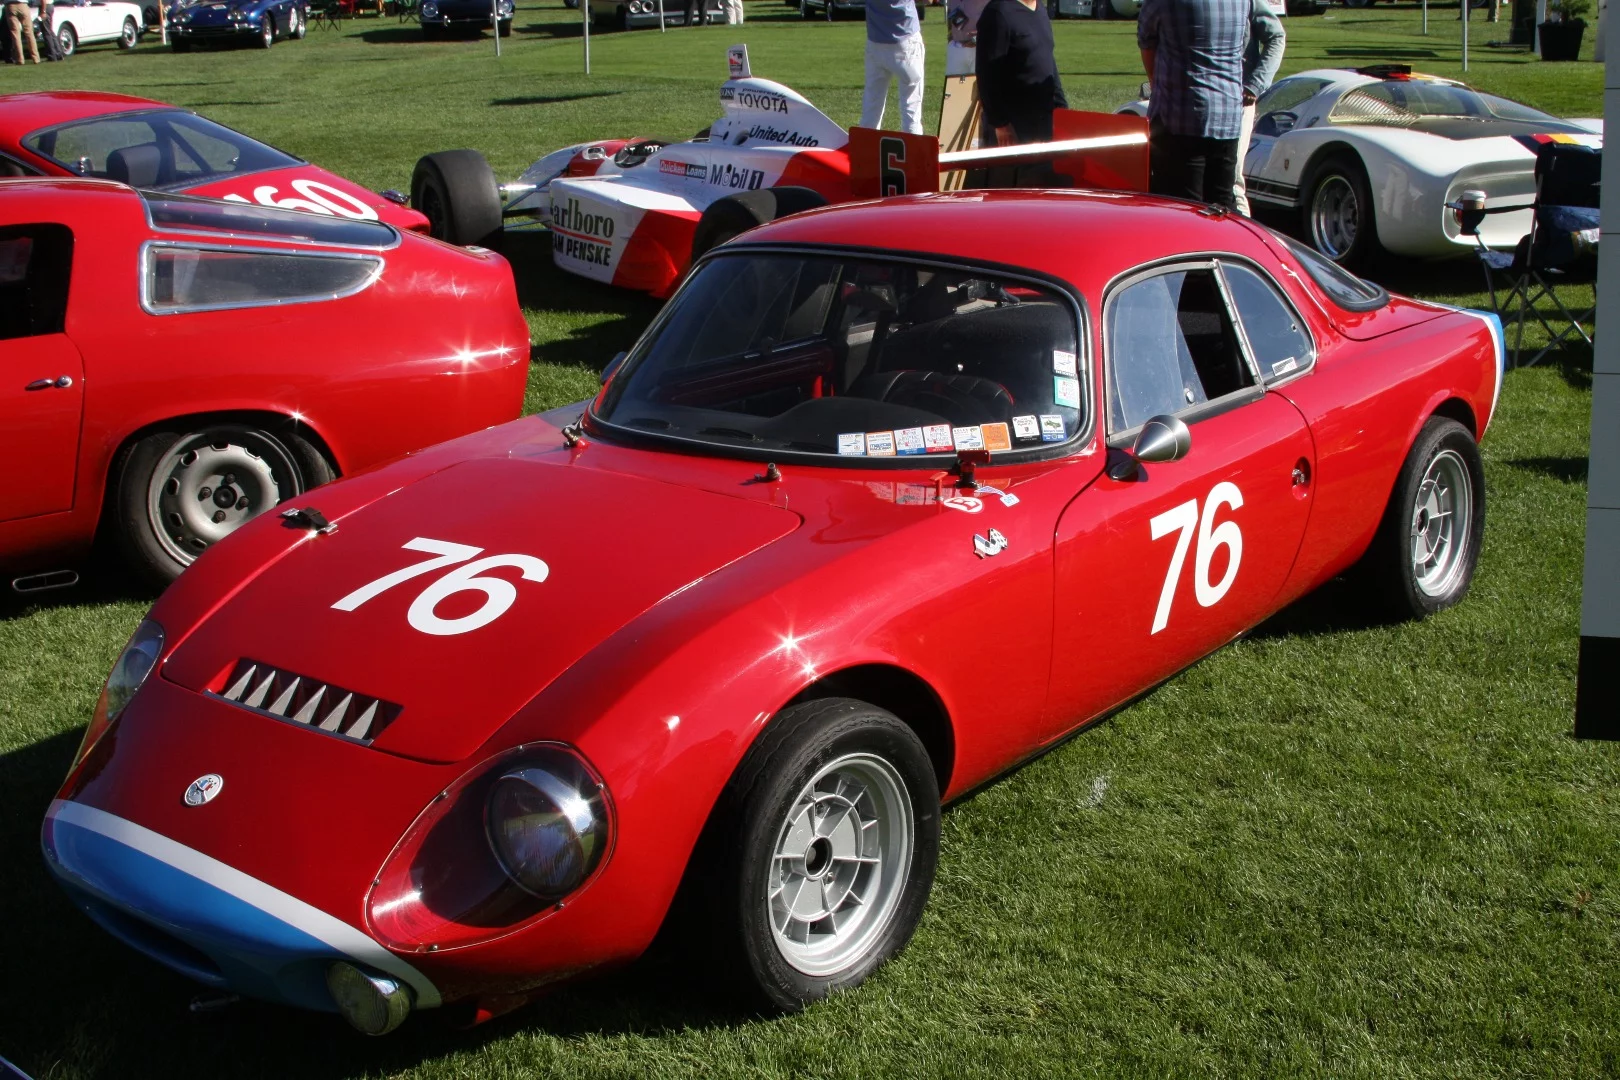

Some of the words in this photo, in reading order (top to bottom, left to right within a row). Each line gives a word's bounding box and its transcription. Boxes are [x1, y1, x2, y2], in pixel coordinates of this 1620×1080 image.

[738, 92, 788, 114] TOYOTA
[749, 125, 787, 144] United
[785, 131, 819, 147] Auto
[660, 159, 686, 175] Quicken
[686, 164, 707, 178] Loans
[710, 164, 749, 189] Mobil
[880, 136, 906, 197] 6
[223, 180, 378, 220] 60
[551, 198, 614, 238] arlboro
[566, 238, 611, 266] PENSKE
[1150, 481, 1244, 635] 76
[330, 537, 549, 635] 76
